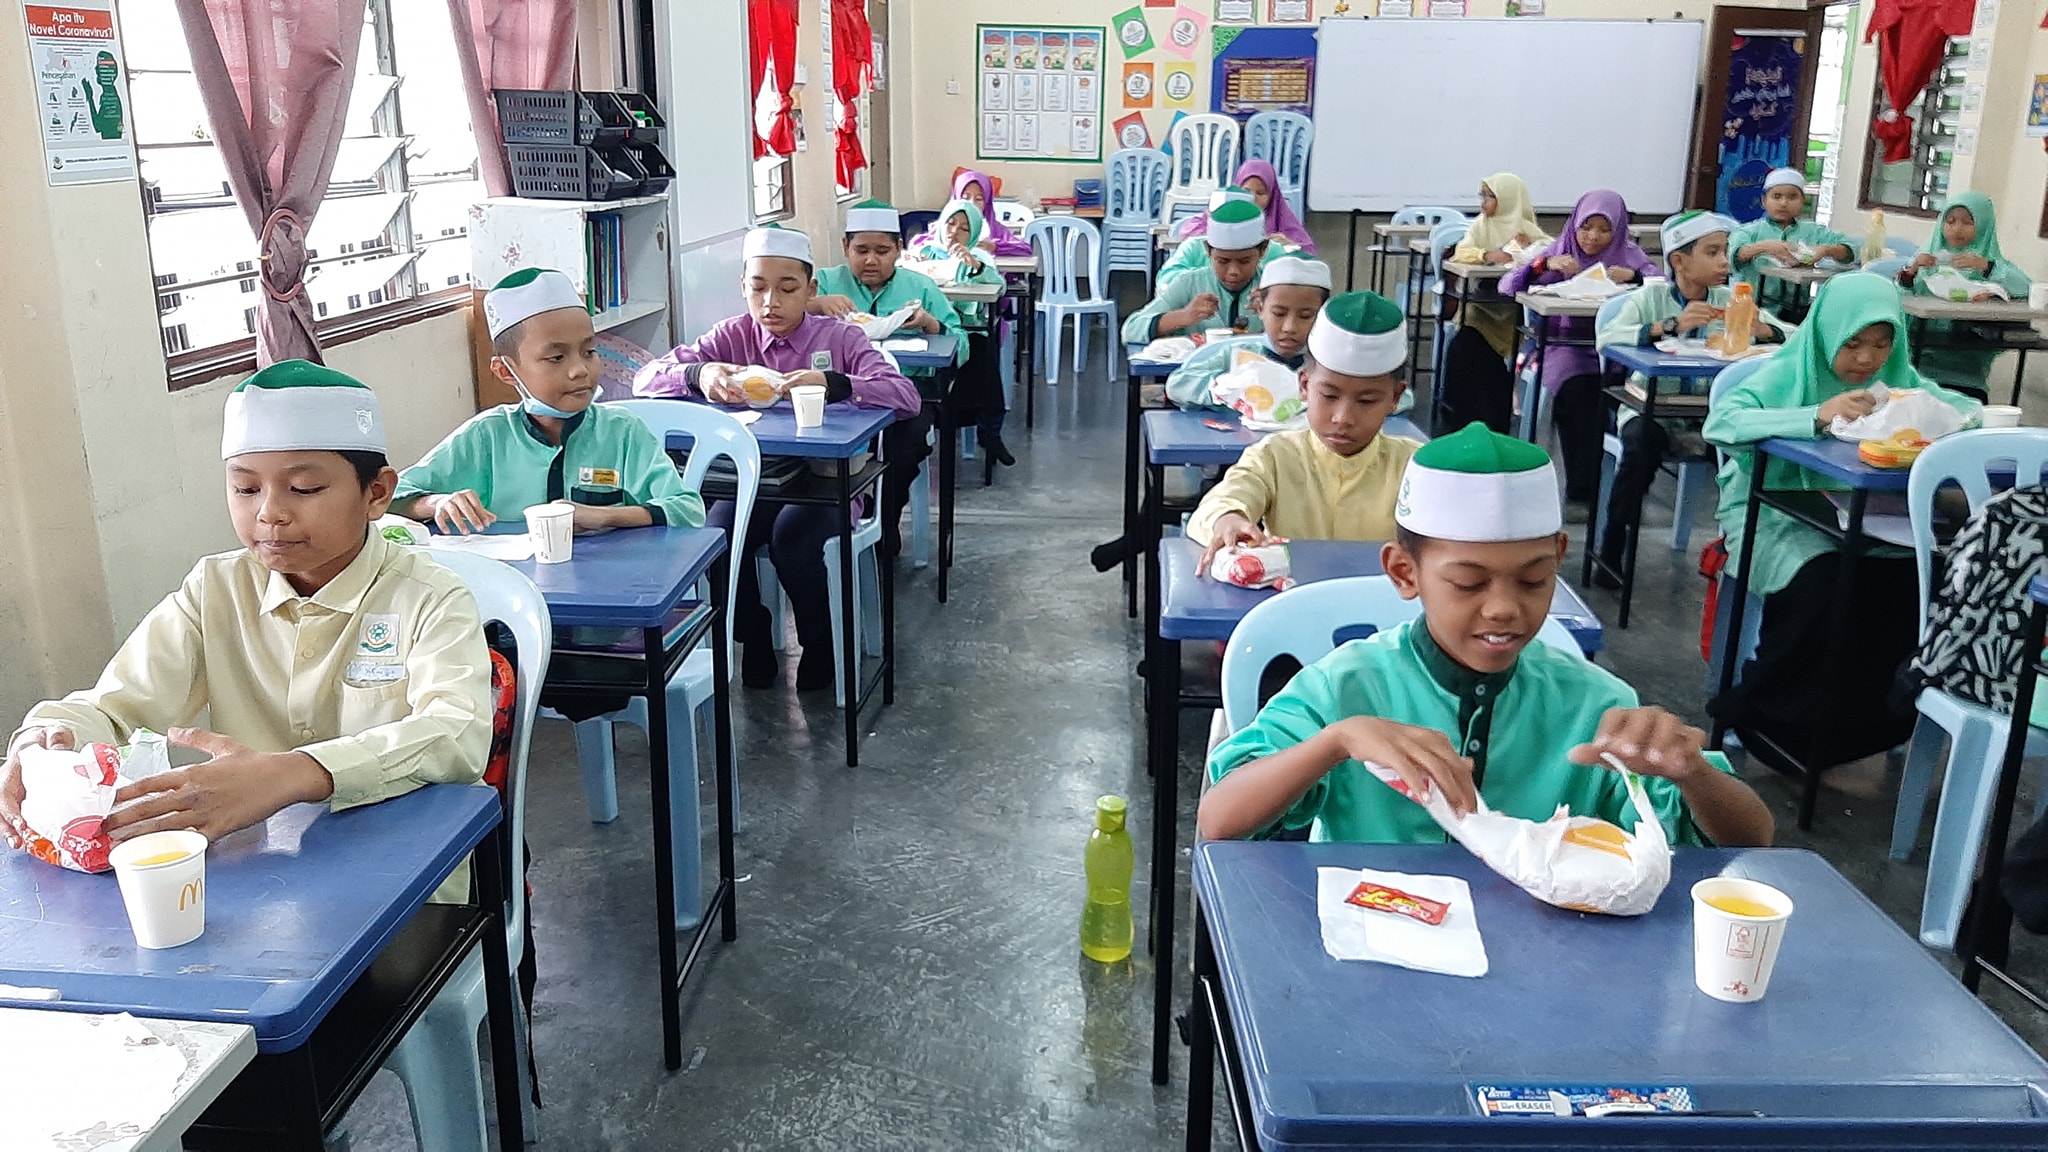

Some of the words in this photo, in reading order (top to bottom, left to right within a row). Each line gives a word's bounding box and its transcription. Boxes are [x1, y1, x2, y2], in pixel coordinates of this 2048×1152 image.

[52, 11, 71, 24] Apa
[73, 12, 85, 23] itu
[29, 23, 57, 35] Novel
[58, 25, 113, 38] Coronavirus?
[1515, 1101, 1552, 1111] ERASER
